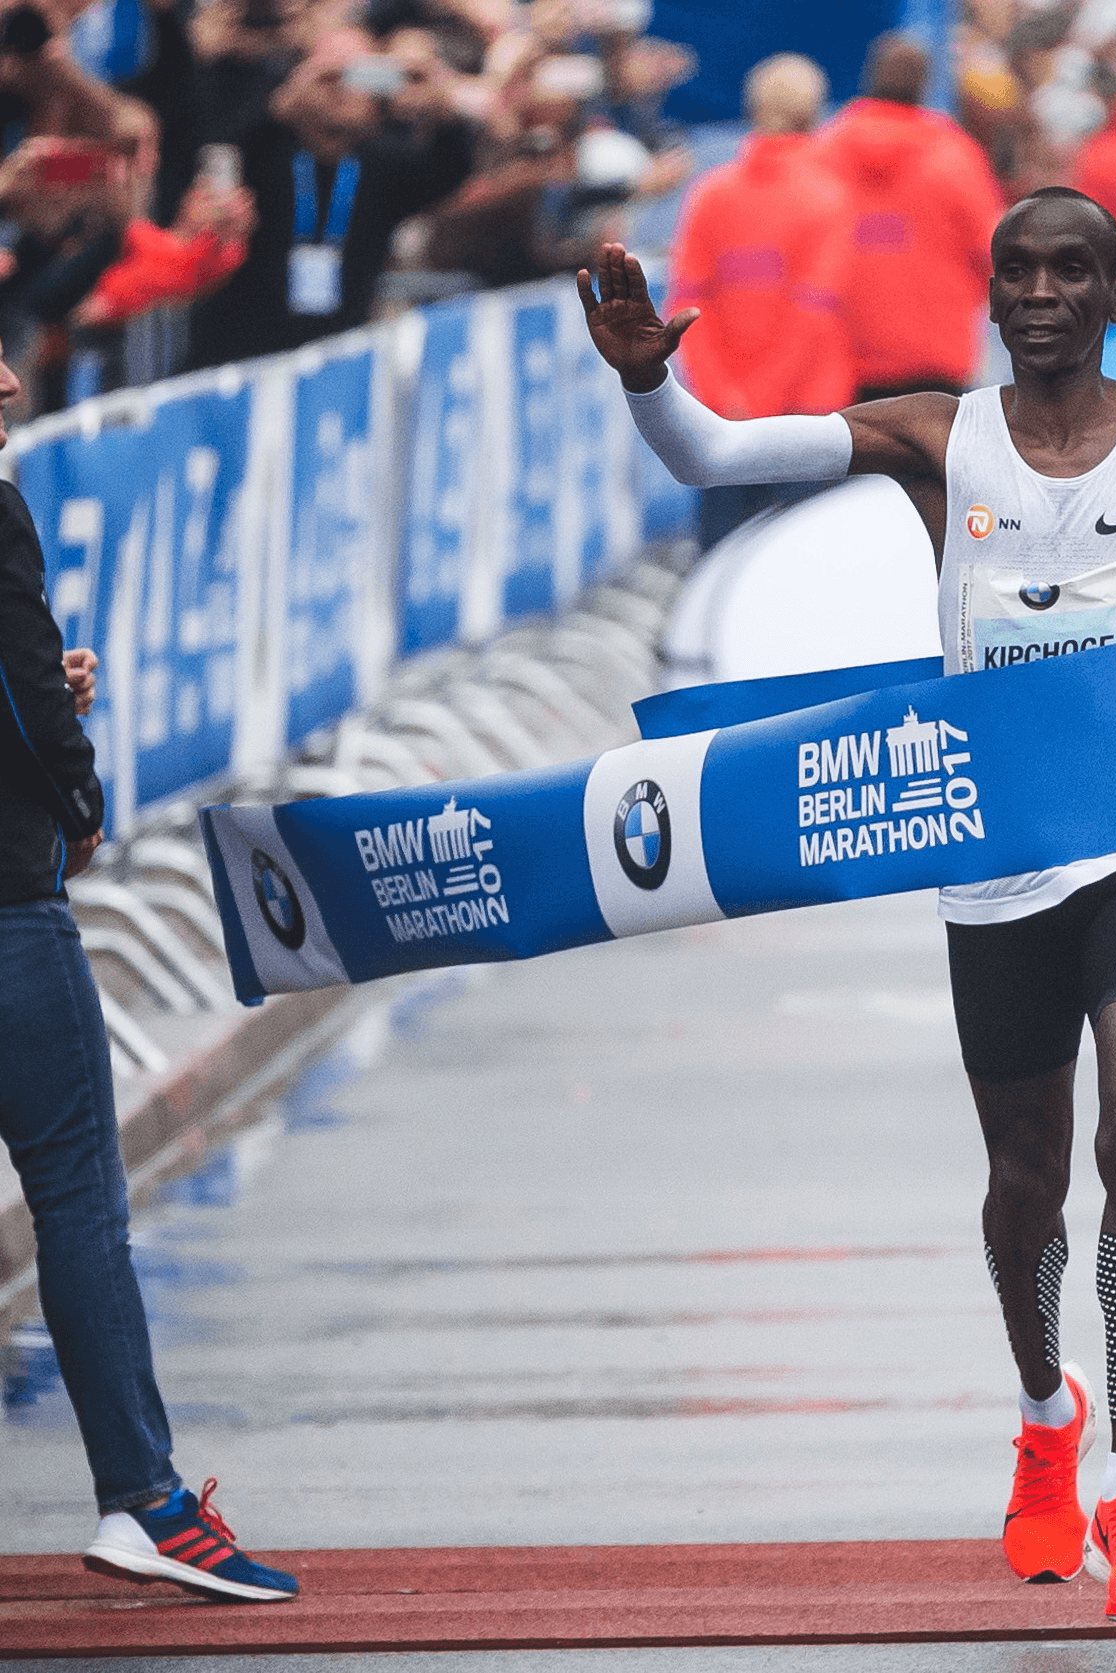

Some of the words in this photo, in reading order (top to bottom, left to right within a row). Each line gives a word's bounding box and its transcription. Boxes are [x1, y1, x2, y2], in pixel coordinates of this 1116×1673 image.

[998, 517, 1021, 531] NN
[798, 730, 881, 788] BMW
[938, 719, 986, 842] 2017
[617, 782, 666, 821] BMW
[798, 782, 886, 828] BERLIN
[354, 818, 424, 872] BMW
[799, 813, 948, 867] MARATHON
[371, 868, 439, 908] BERLIN
[470, 807, 510, 926] 2017
[386, 898, 488, 942] MARATHON
